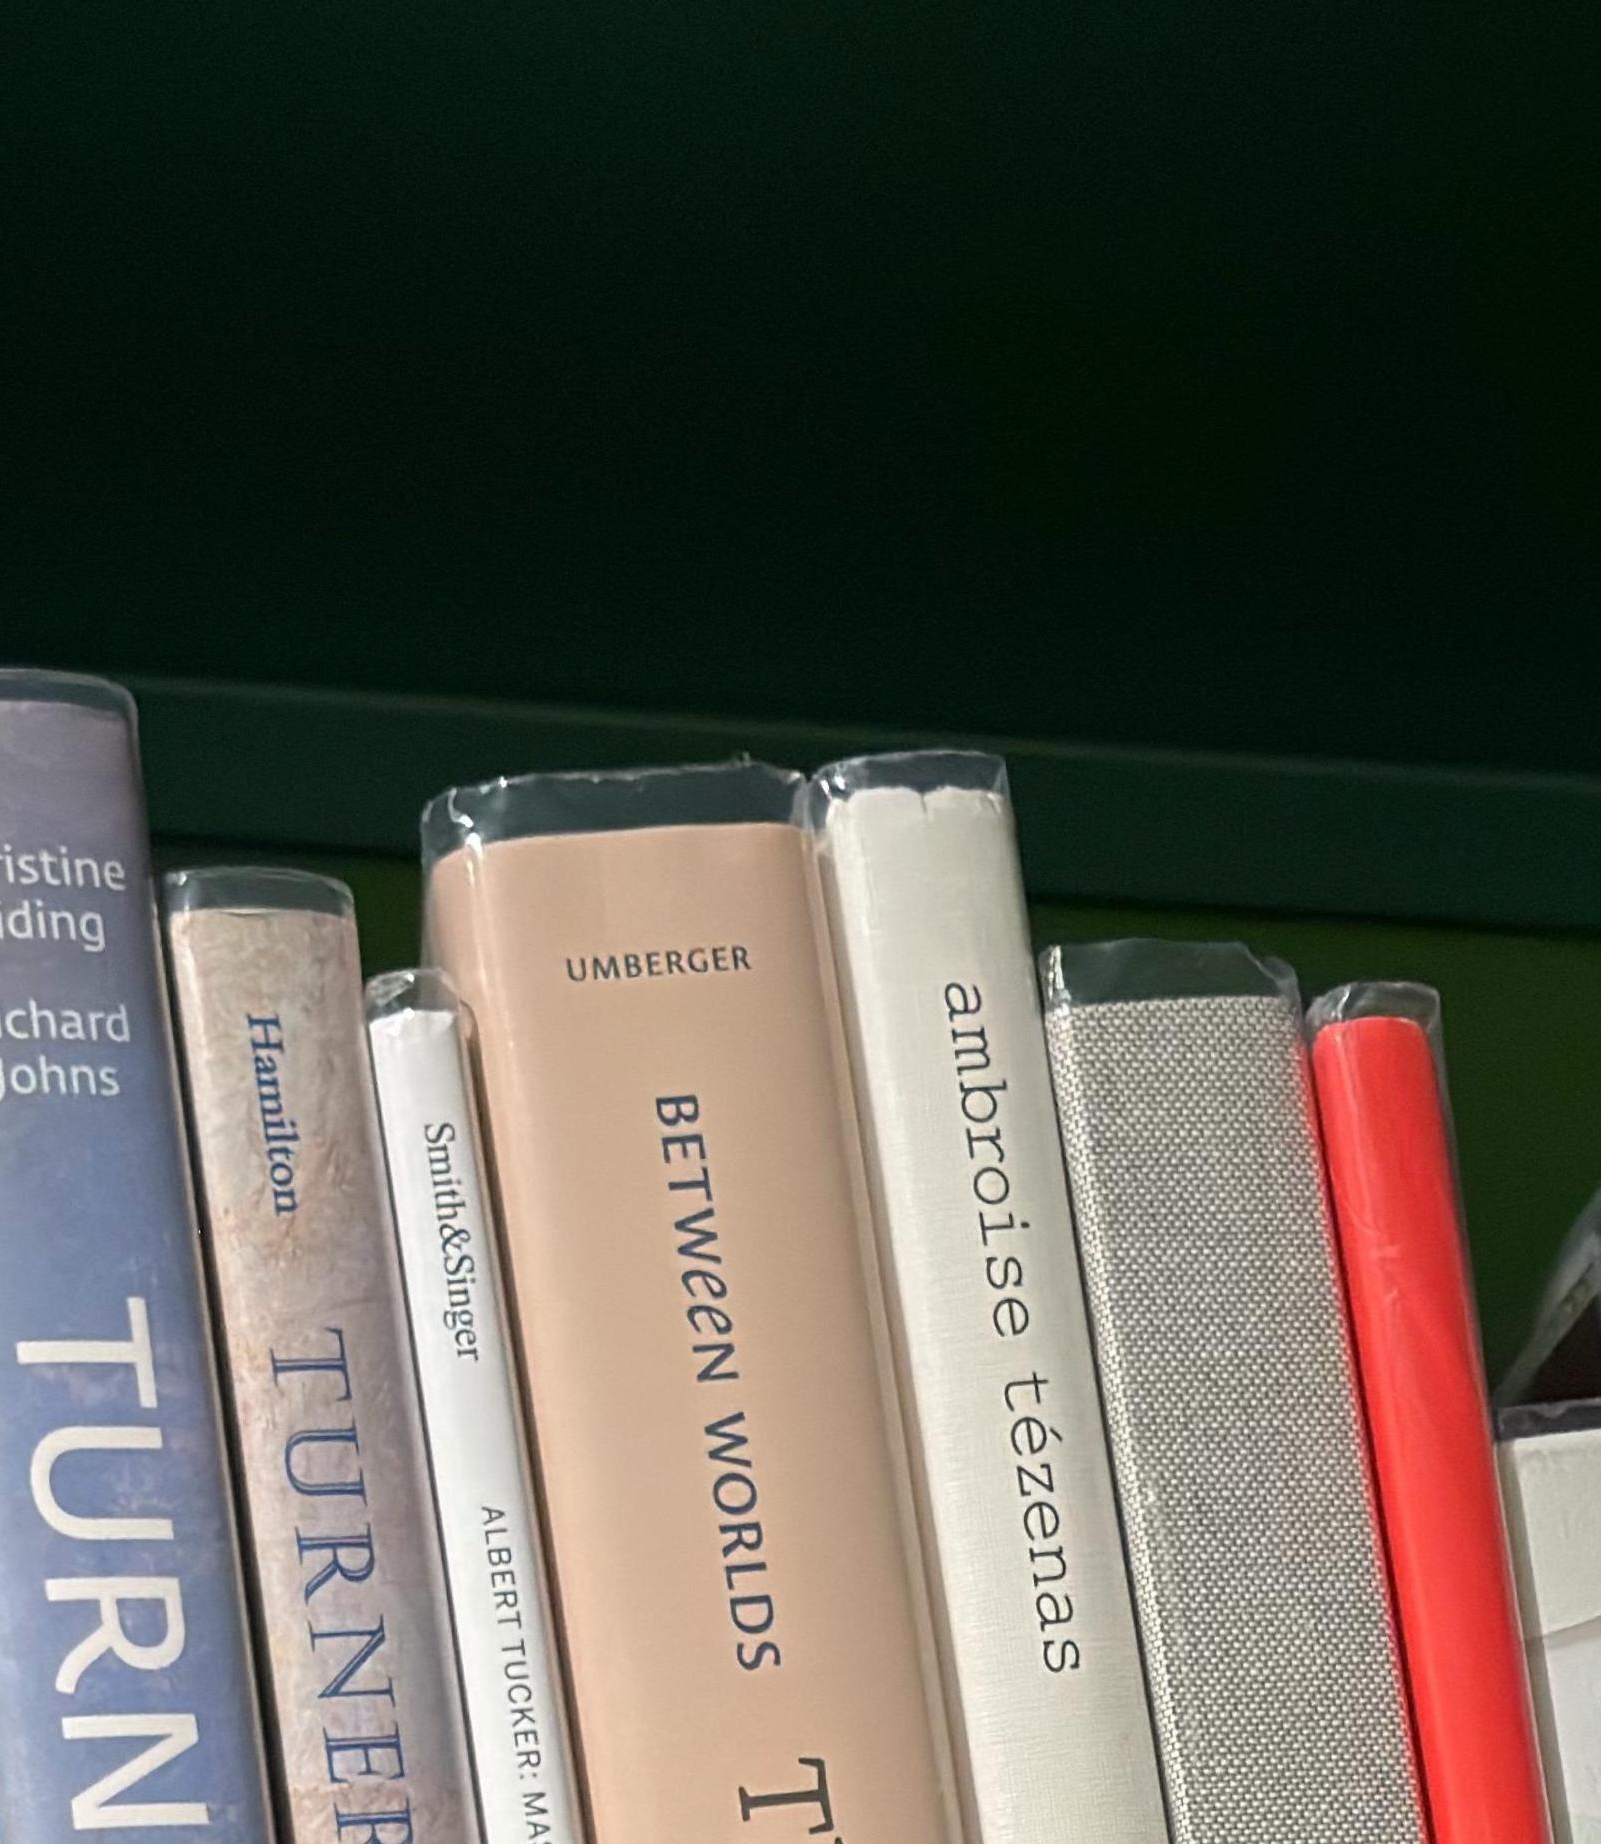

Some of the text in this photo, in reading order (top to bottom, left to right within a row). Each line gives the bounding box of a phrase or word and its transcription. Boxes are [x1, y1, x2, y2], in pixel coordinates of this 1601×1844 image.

[567, 945, 752, 982] UMBERGER
[246, 1013, 302, 1216] Hamilton
[422, 1122, 480, 1362] Smith&Singer
[943, 980, 1082, 1674] ambroise tézenas
[481, 1505, 521, 1629] ALBERT
[704, 1410, 781, 1671] WORLDS
[500, 1636, 544, 1779] TUCKER:
